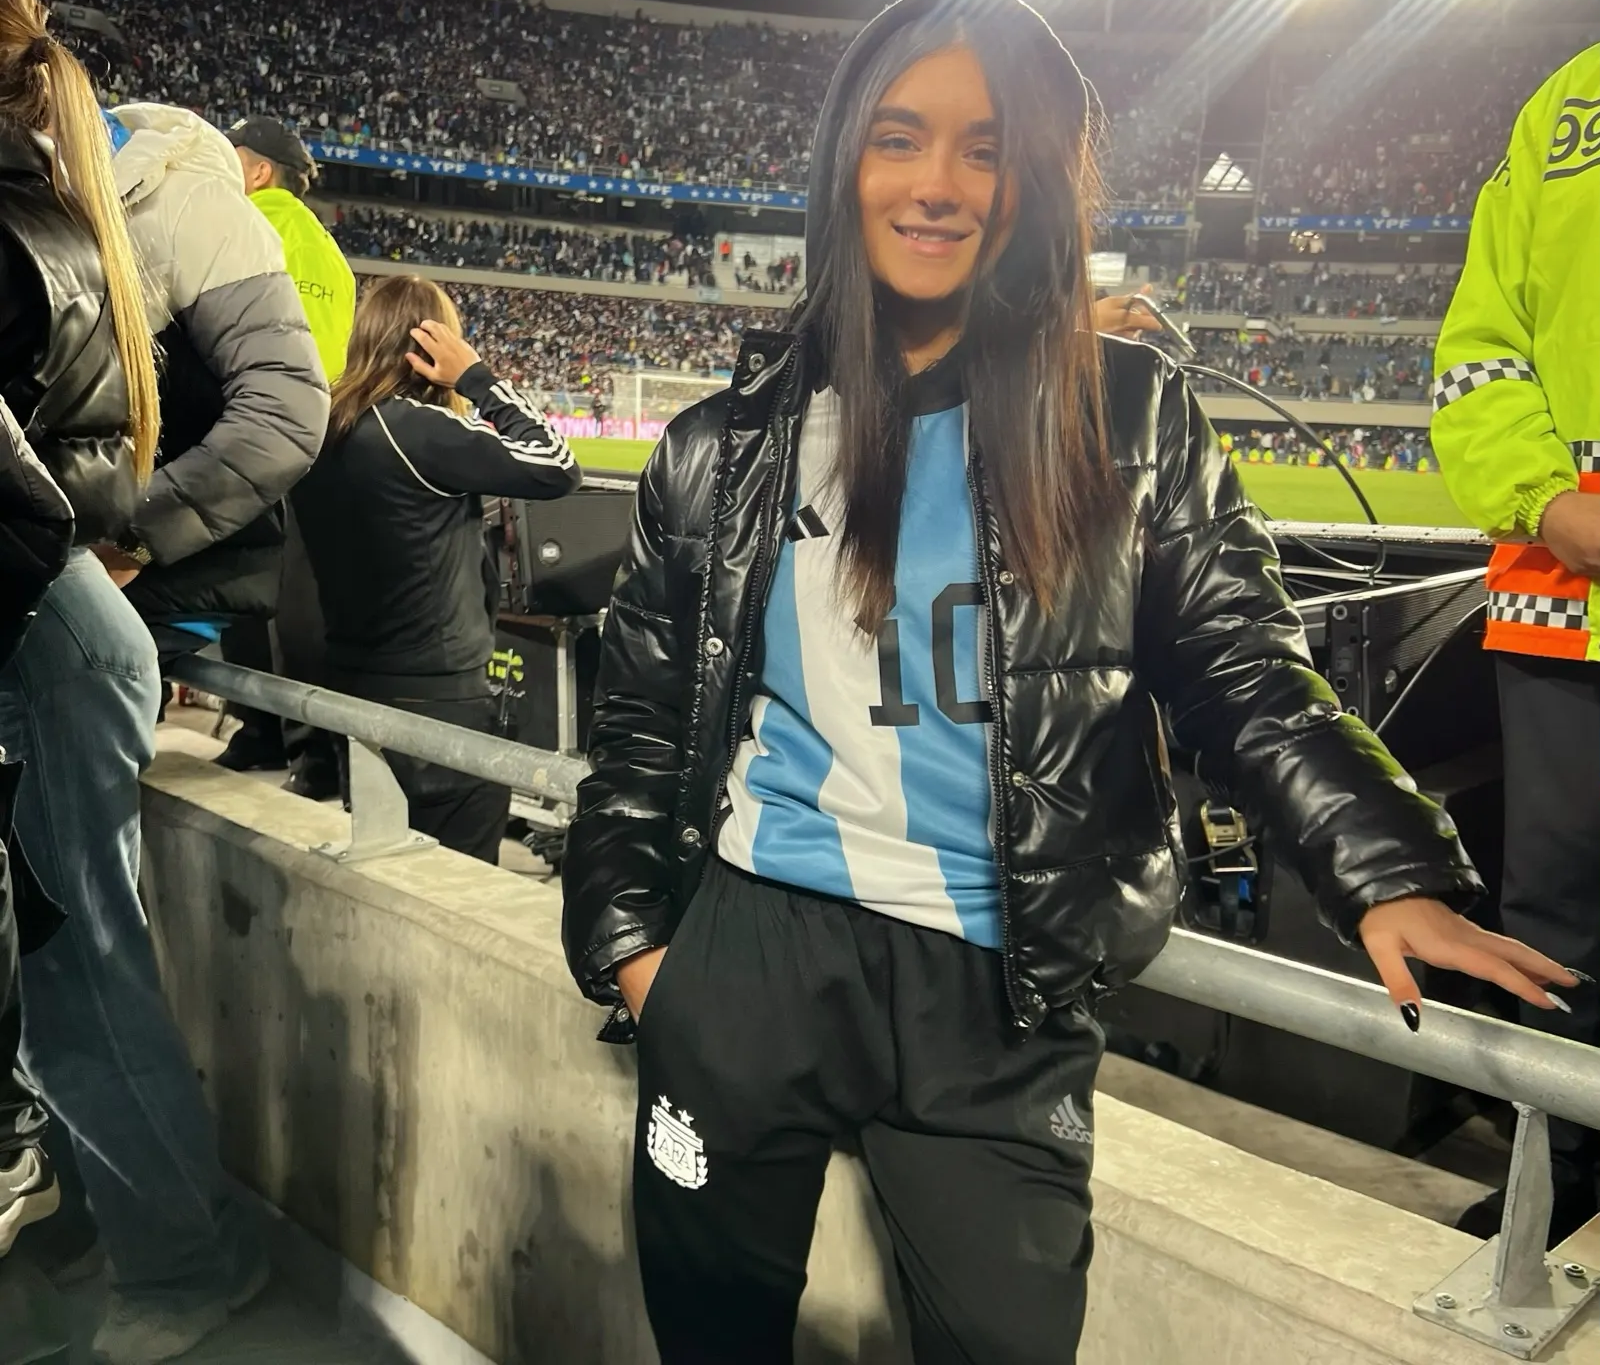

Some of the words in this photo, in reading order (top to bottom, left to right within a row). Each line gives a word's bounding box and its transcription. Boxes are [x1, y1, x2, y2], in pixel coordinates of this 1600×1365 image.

[321, 144, 360, 160] YPF
[429, 159, 467, 174] YPF
[534, 172, 571, 185] YPF
[637, 182, 673, 195] YPF
[738, 191, 774, 202] YPF
[1141, 214, 1177, 225] YPF
[1262, 216, 1299, 227] YPF
[1372, 218, 1412, 229] YPF
[1050, 1124, 1094, 1145] adida
